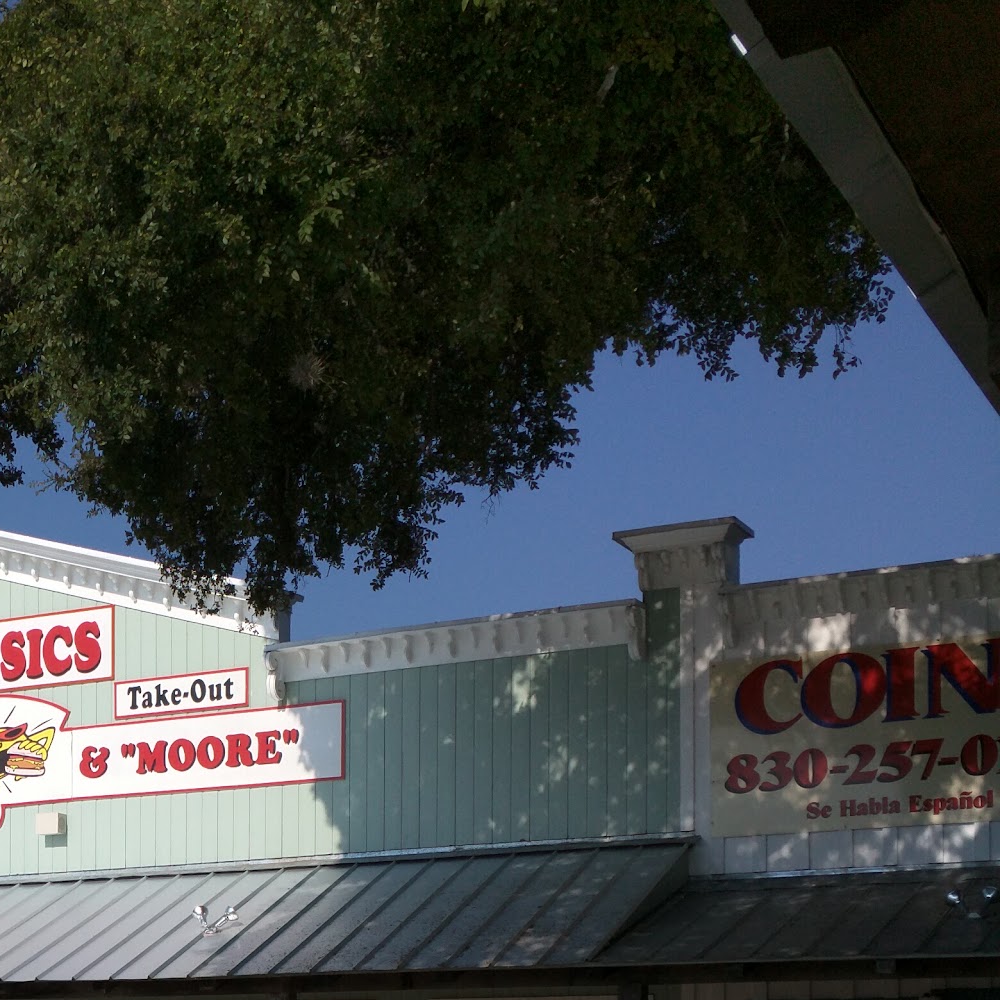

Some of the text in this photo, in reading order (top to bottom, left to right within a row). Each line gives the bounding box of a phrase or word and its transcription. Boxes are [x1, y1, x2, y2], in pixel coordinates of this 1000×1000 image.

[127, 678, 234, 710] Take-Out
[734, 638, 1000, 735] COIN
[79, 728, 299, 779] & "MOORE"
[724, 734, 1000, 794] 830-257-0
[806, 790, 993, 819] Se Habla Español
